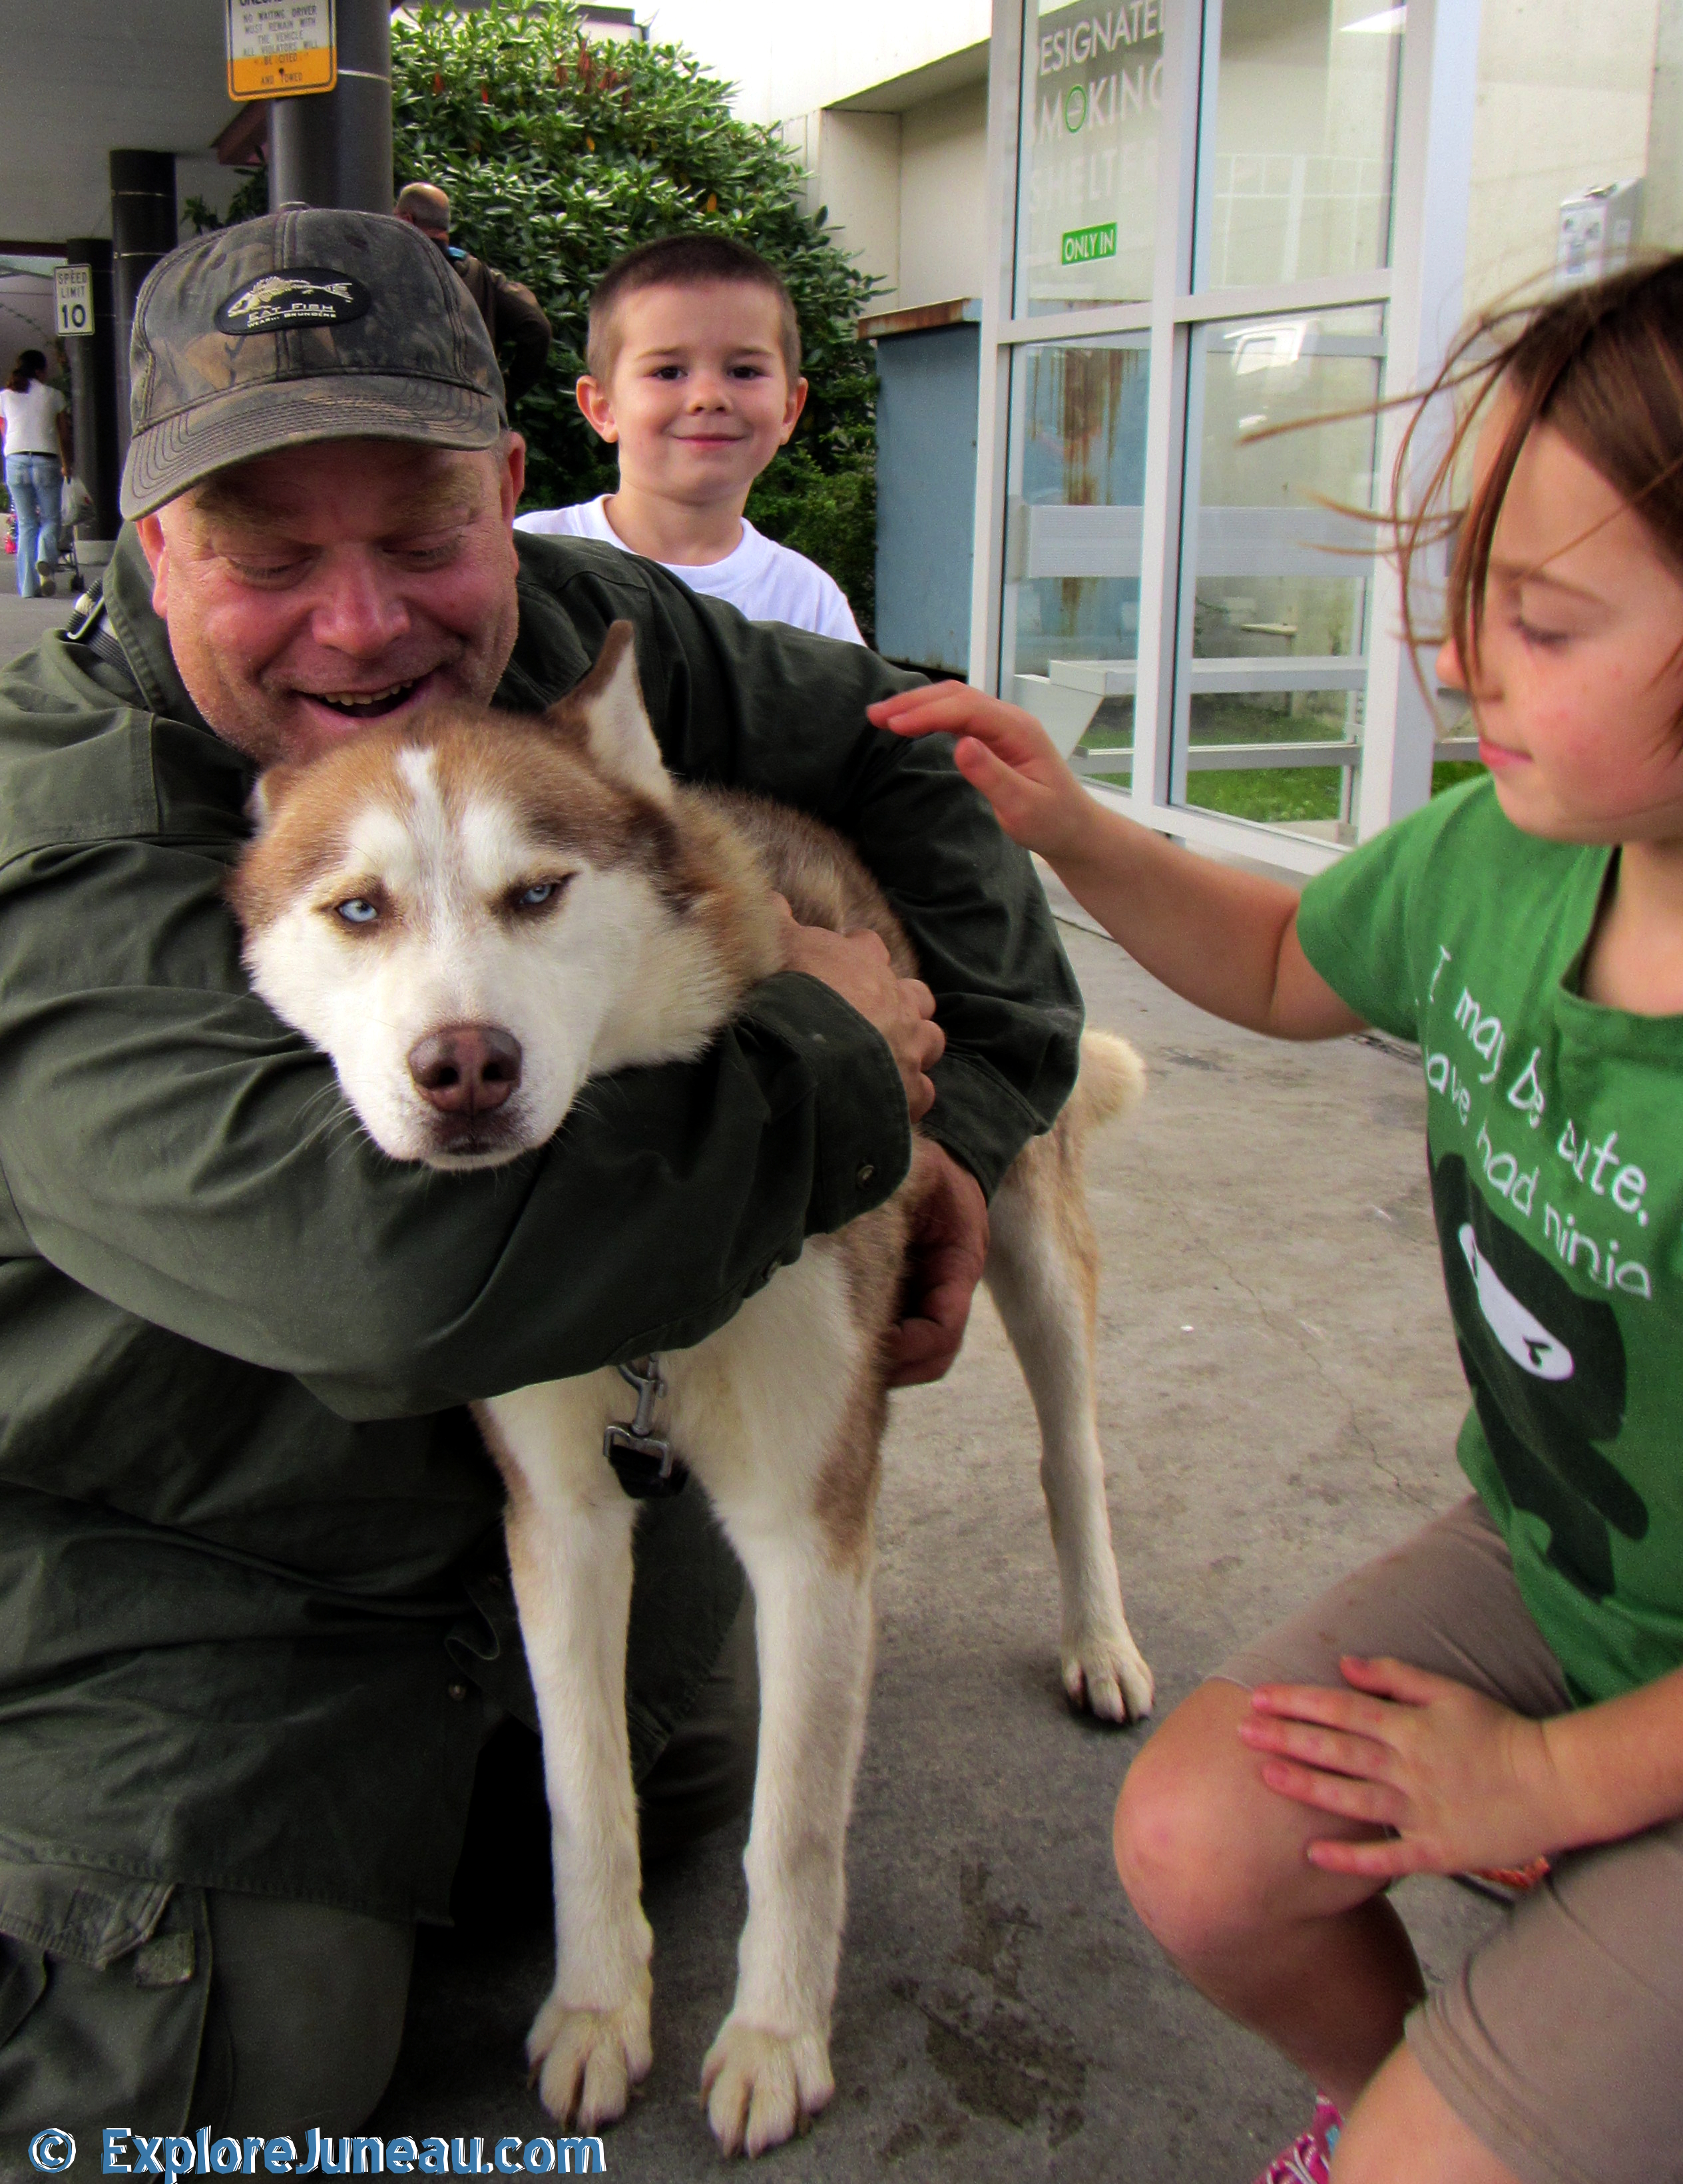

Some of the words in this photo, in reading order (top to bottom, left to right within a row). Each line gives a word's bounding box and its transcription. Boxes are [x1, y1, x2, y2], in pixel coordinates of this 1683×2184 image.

[243, 14, 253, 23] NO
[258, 9, 285, 21] WAITING
[292, 5, 317, 17] DRIVER
[245, 24, 262, 34] MUST
[268, 21, 294, 31] REMAIN
[300, 18, 316, 27] WITH
[258, 35, 270, 45] THE
[276, 30, 304, 42] VEHICLE
[244, 47, 255, 56] ALL
[262, 42, 298, 54] VIOLATORS
[303, 40, 318, 49] WILL
[264, 56, 272, 65] BE
[278, 53, 297, 63] CITED
[262, 75, 274, 85] AND
[1065, 232, 1098, 261] ONLY
[1100, 228, 1114, 255] IN
[59, 272, 87, 284] SPEED
[61, 286, 85, 298] LIMIT
[62, 304, 86, 328] 10
[249, 306, 281, 321] EAT
[1454, 985, 1506, 1085] may
[1507, 1046, 1545, 1129] be
[1425, 1045, 1471, 1127] ave
[1544, 1201, 1652, 1301] ninja
